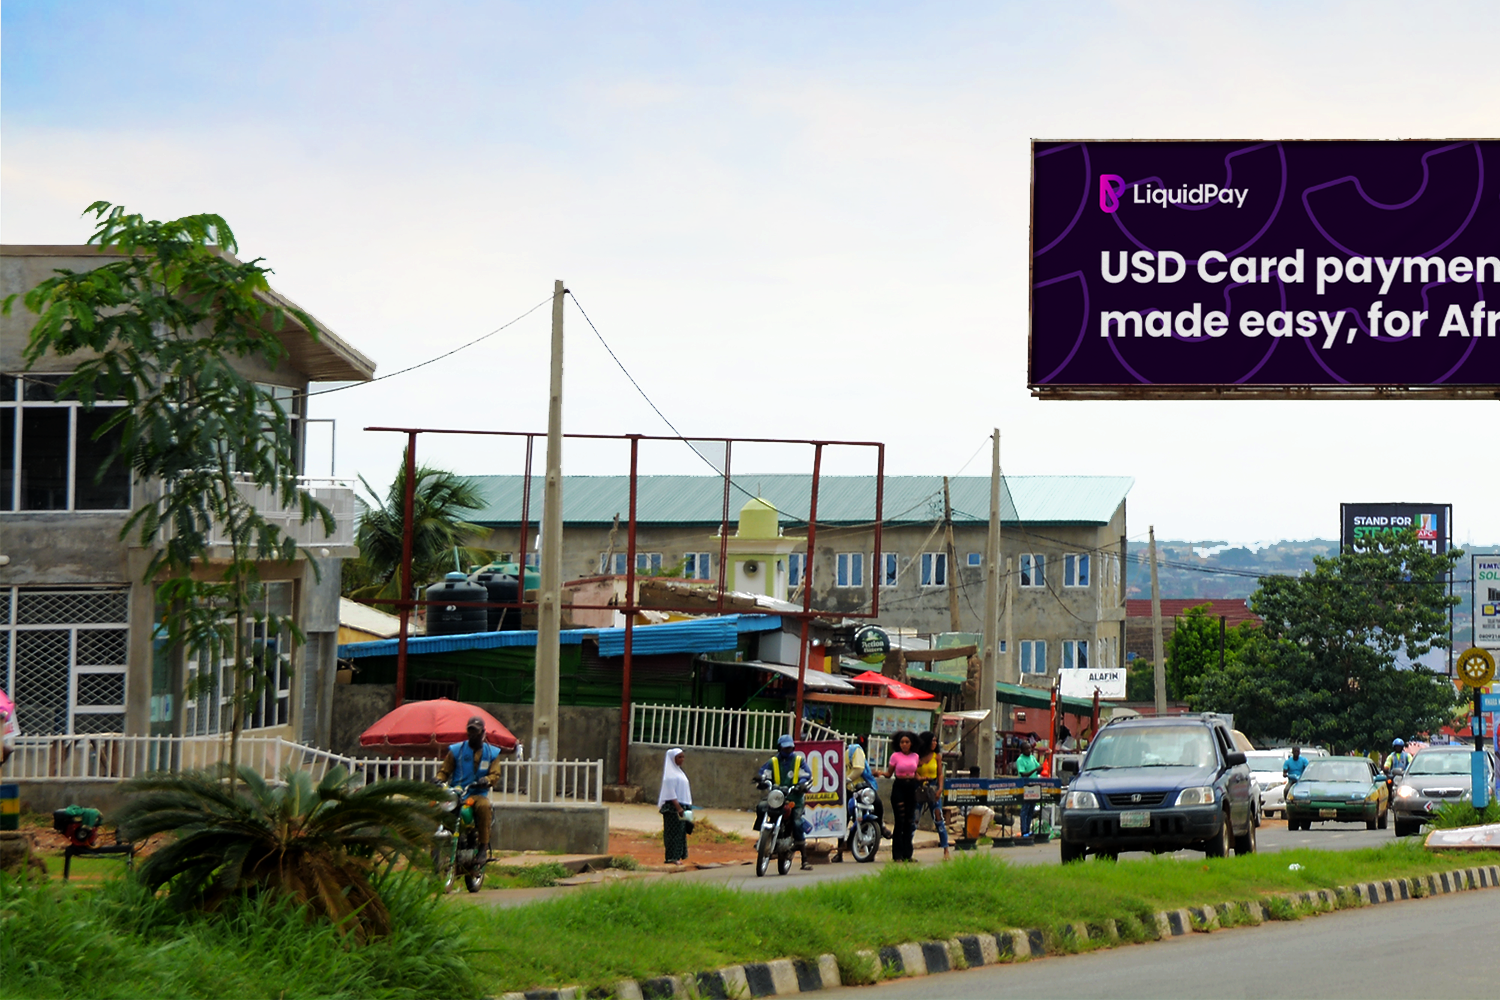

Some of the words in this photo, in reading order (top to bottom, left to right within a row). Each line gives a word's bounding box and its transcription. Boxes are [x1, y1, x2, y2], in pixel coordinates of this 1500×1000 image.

[1133, 183, 1249, 209] LiquidPay
[1100, 250, 1187, 284] USD
[1196, 248, 1305, 284] Card
[1100, 302, 1230, 338] made
[1238, 309, 1359, 350] easy,
[1366, 300, 1429, 338] for
[1354, 516, 1389, 526] STAND
[1390, 516, 1412, 526] FOR
[1088, 672, 1119, 681] ALAFIN
